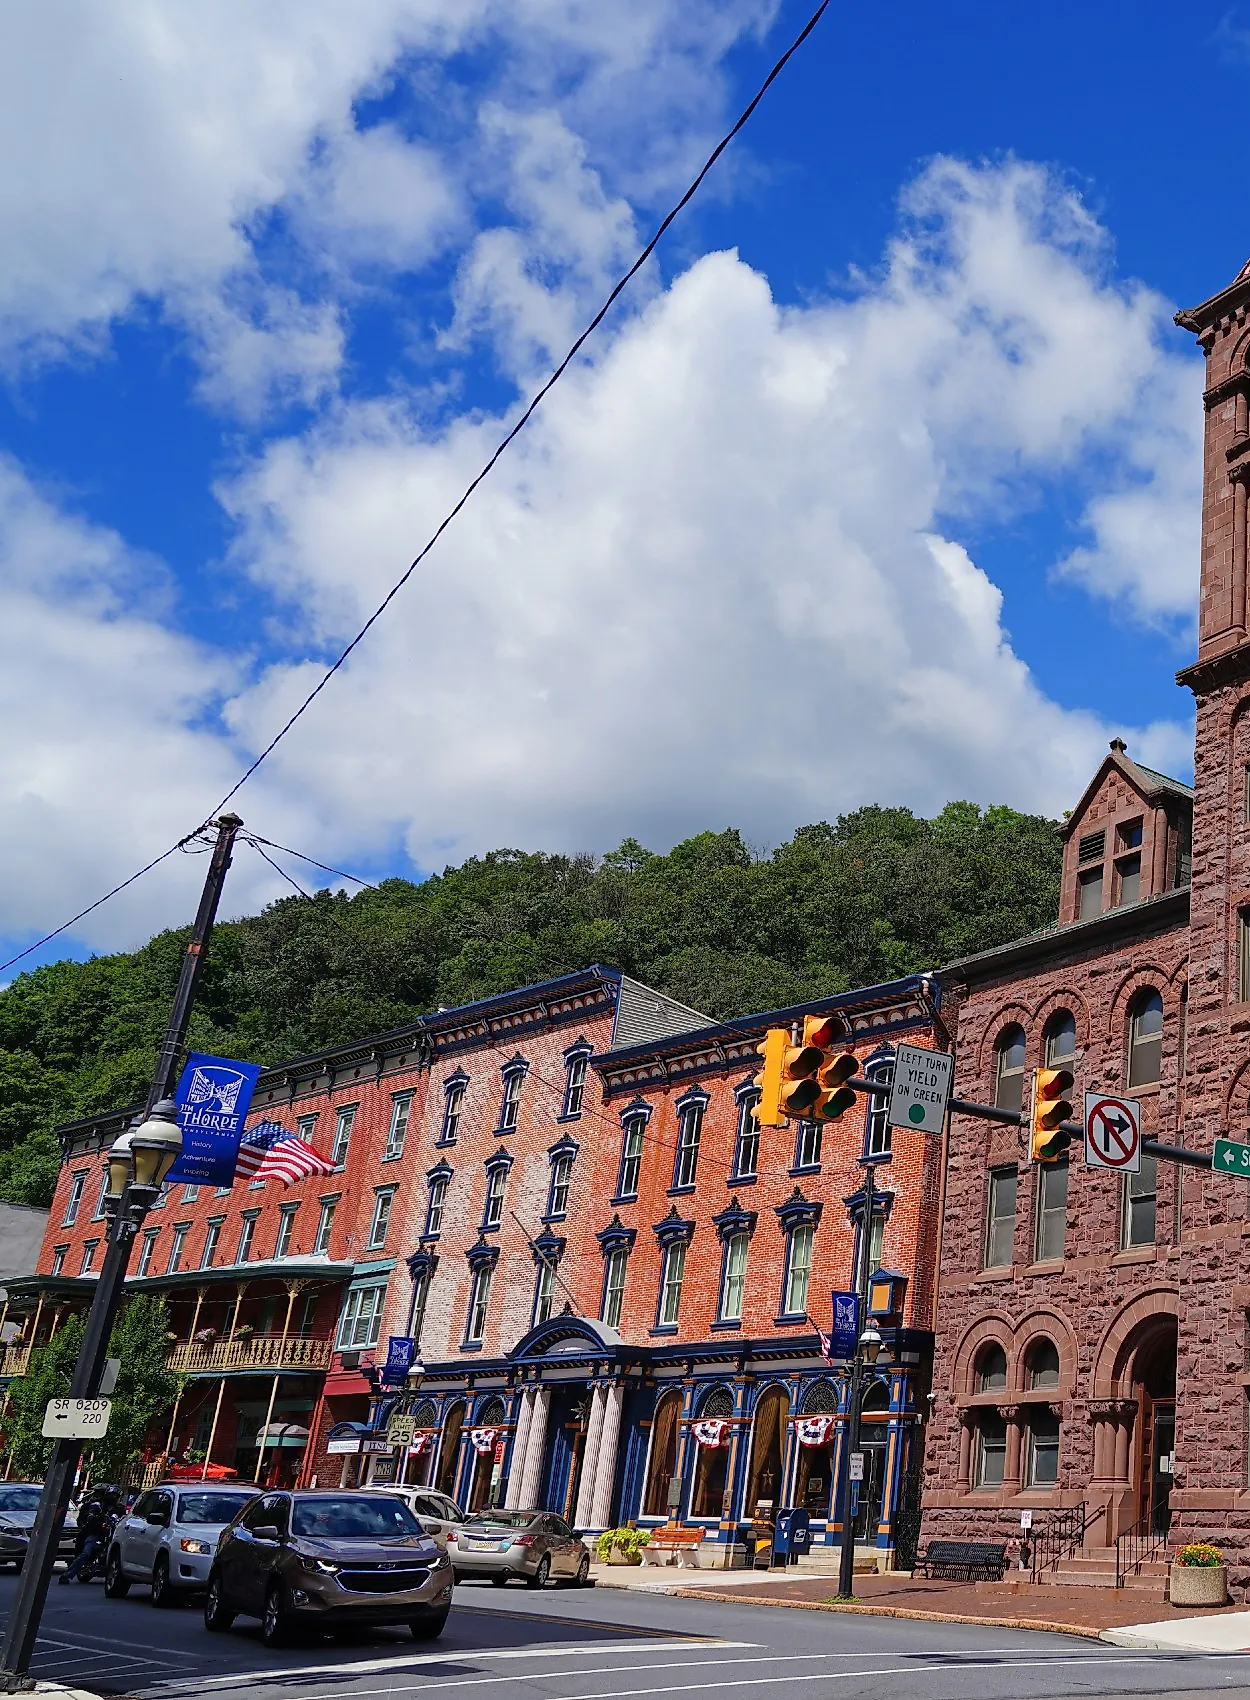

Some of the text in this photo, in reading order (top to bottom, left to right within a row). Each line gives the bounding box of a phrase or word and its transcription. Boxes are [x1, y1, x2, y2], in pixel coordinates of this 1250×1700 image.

[901, 1052, 948, 1072] LEFT TURN
[908, 1068, 938, 1087] YIELD
[898, 1084, 942, 1104] ON GREEN
[180, 1103, 194, 1112] JIM
[181, 1108, 239, 1130] THORPE
[191, 1140, 212, 1150] History
[183, 1167, 210, 1178] Inspiring
[54, 1400, 108, 1410] SR 0209
[82, 1414, 101, 1423] 220
[390, 1430, 410, 1442] 25
